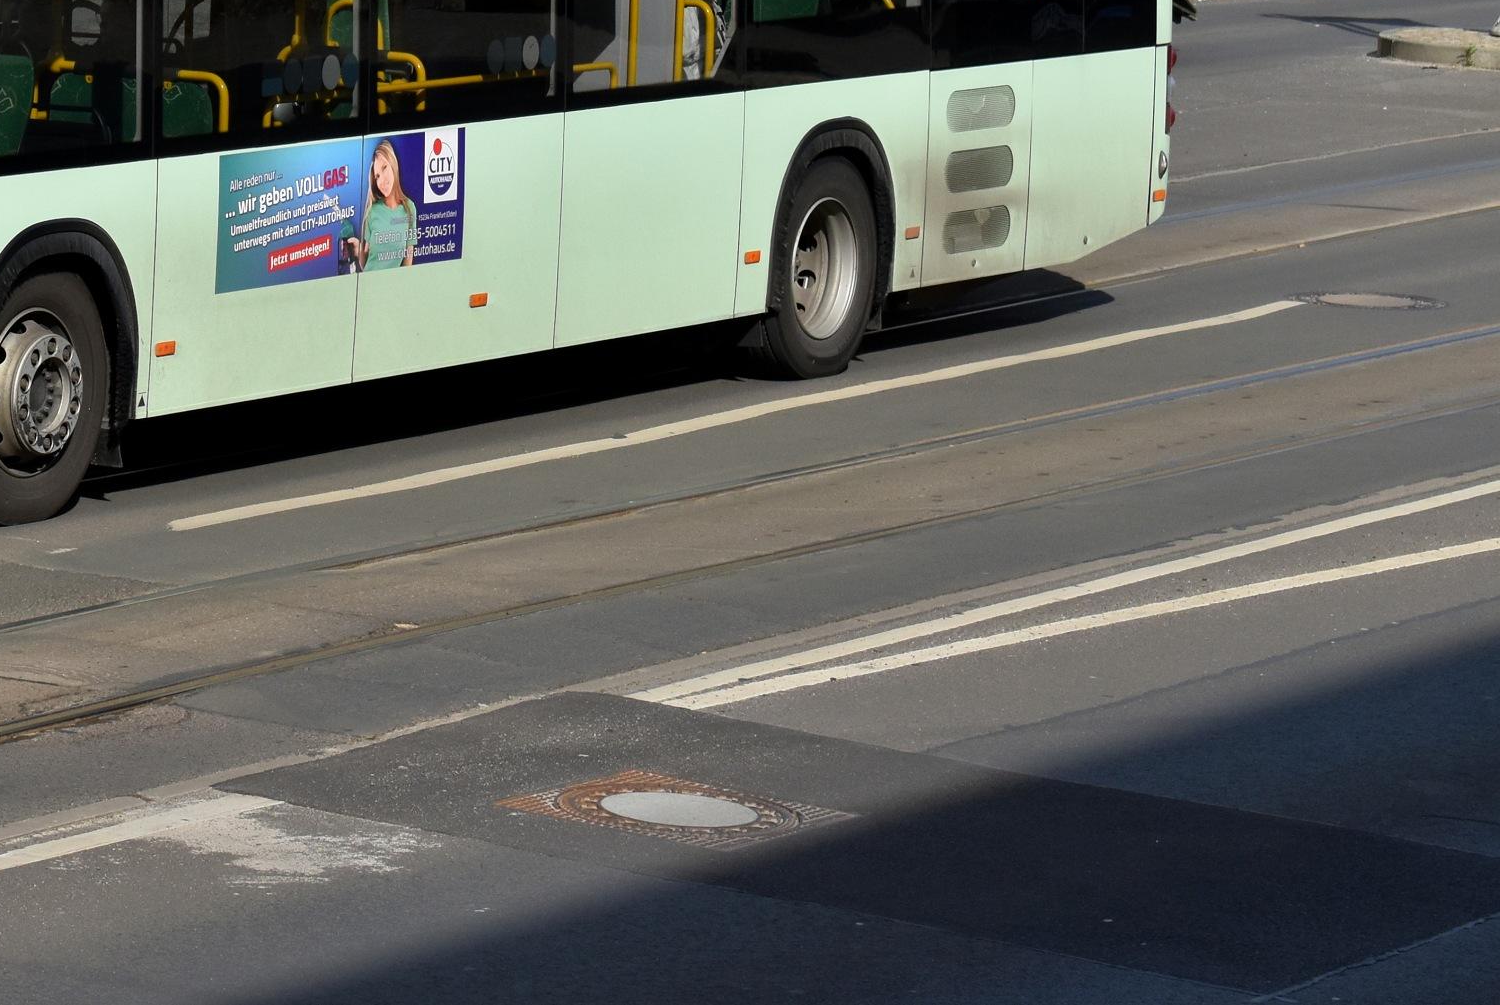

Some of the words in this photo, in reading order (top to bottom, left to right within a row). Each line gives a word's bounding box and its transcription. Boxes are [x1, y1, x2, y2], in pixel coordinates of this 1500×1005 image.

[429, 156, 453, 174] CITY
[230, 178, 243, 192] Alle
[243, 173, 263, 189] reden
[264, 170, 276, 182] nur
[238, 193, 257, 215] wir
[259, 185, 294, 213] geben
[296, 165, 349, 197] VOLLGAS!
[430, 175, 453, 184] AUTOHAUS
[230, 211, 292, 237] Umweltfreundlich
[292, 204, 306, 218] und
[307, 195, 339, 216] preiswert
[233, 234, 271, 252] unterwegs
[272, 227, 284, 241] mit
[284, 223, 300, 237] dem
[301, 205, 355, 232] CITY-AUTOHAUS
[404, 223, 456, 241] 0335-5004511
[270, 251, 288, 270] Jetzt
[289, 239, 330, 261] umsteigen!
